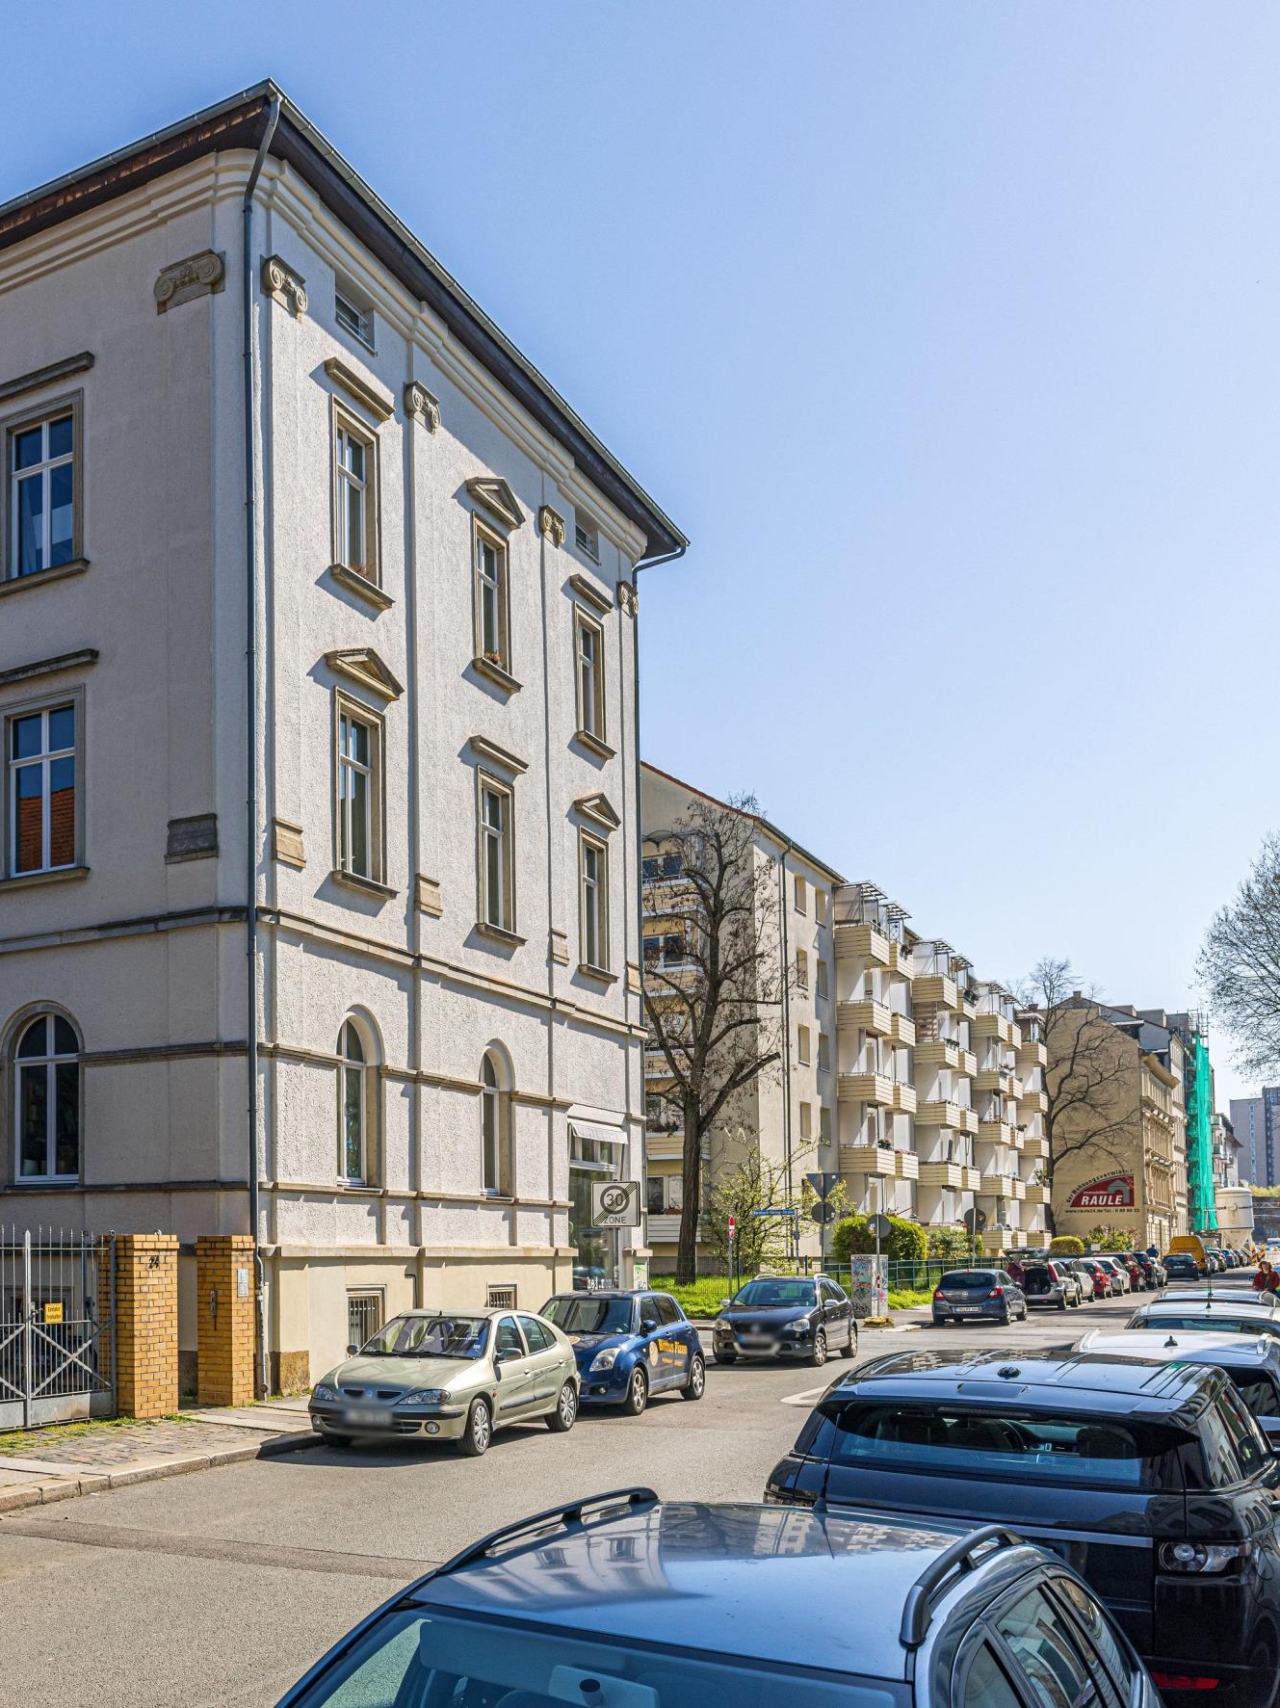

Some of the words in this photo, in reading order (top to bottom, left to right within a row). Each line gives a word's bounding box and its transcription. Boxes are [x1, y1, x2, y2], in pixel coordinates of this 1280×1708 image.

[606, 1193, 623, 1207] 30
[1081, 1195, 1123, 1205] RAULE
[603, 1216, 627, 1224] ZONE
